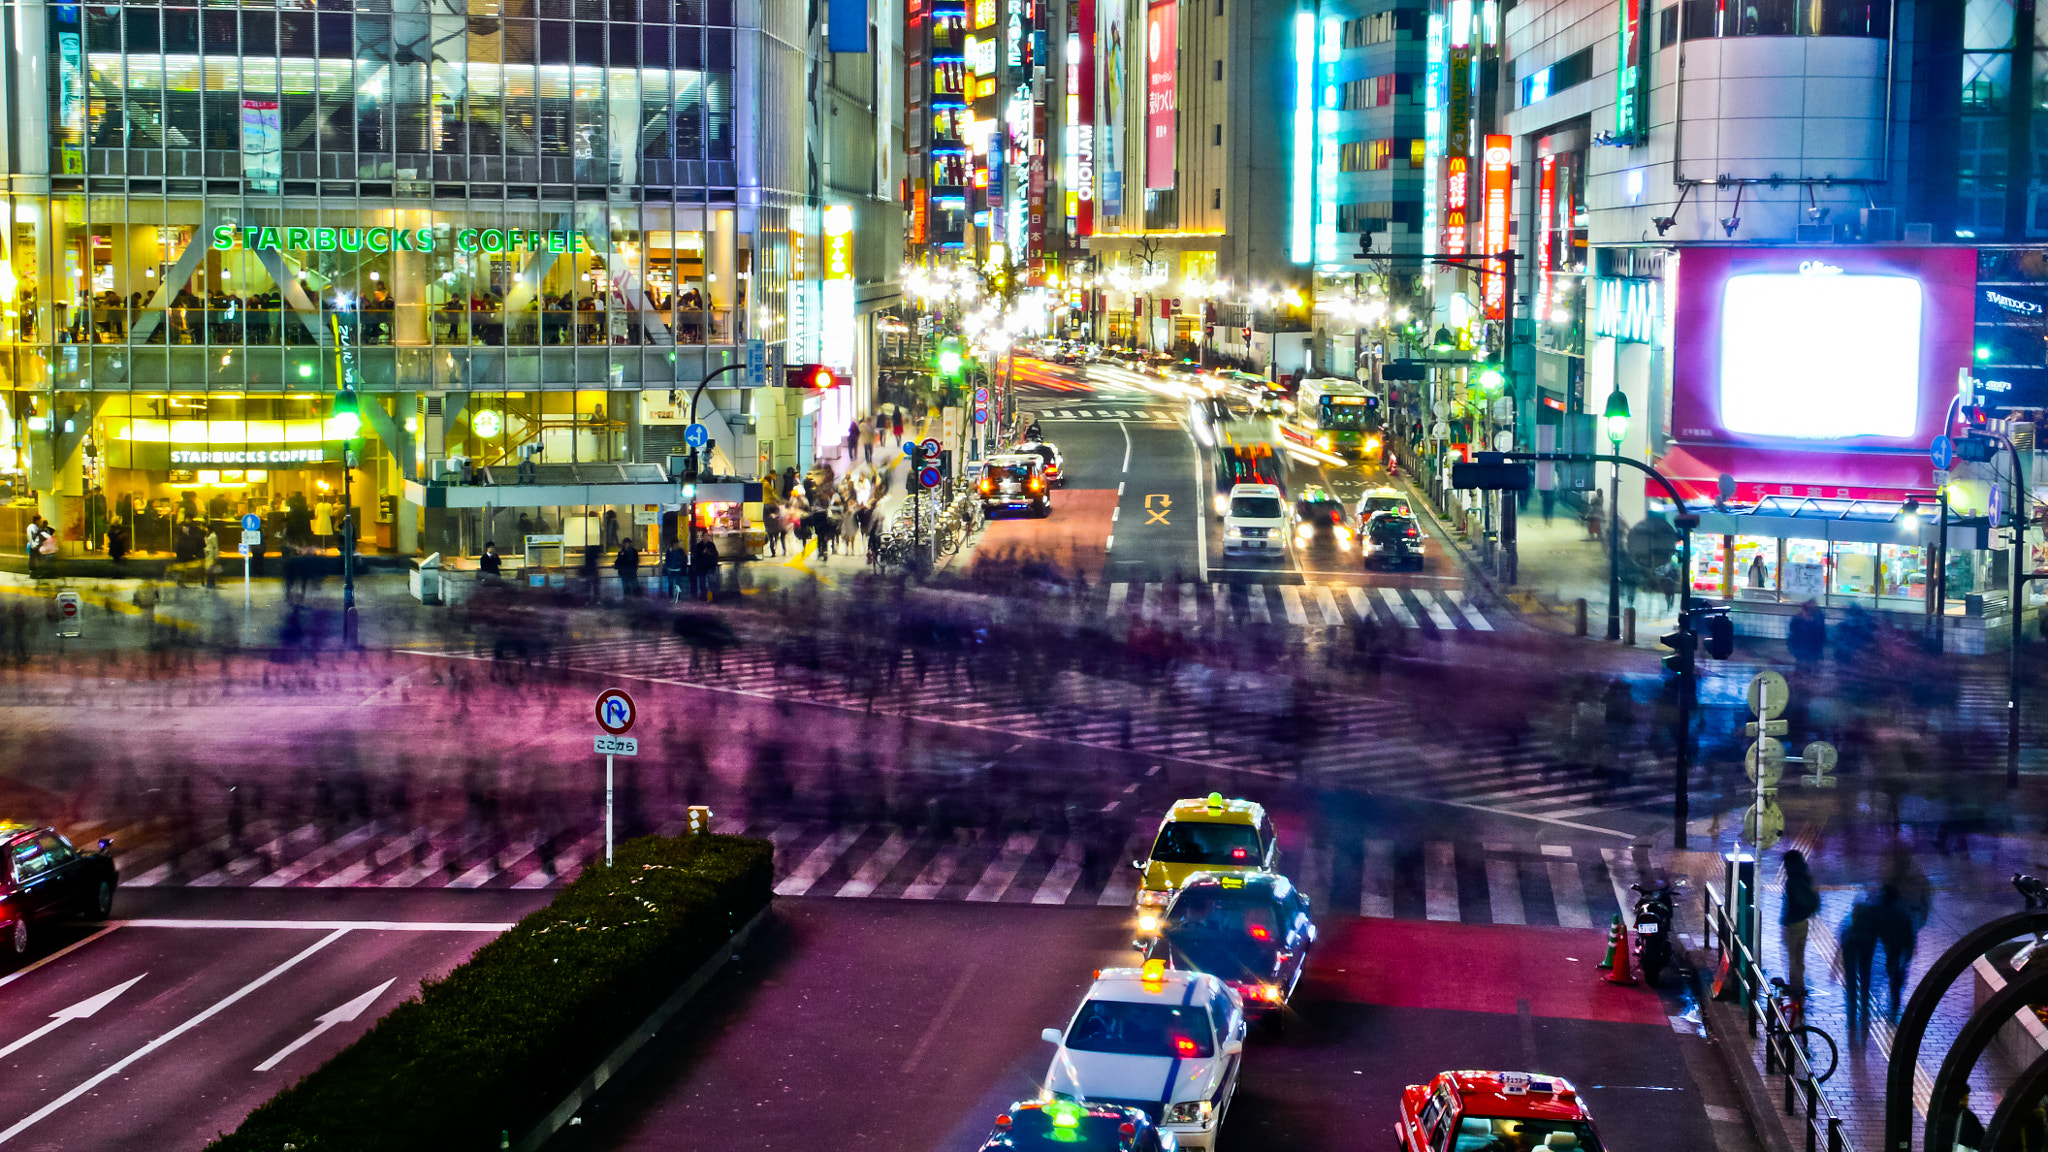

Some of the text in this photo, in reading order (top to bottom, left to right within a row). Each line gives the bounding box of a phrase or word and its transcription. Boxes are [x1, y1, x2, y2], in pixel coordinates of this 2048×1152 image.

[212, 225, 584, 254] STARBUCKS COFFEE
[170, 449, 324, 463] STARBUCKS COFFEE
[1752, 484, 1851, 500] 千里薬品
[597, 740, 634, 751] ここから
